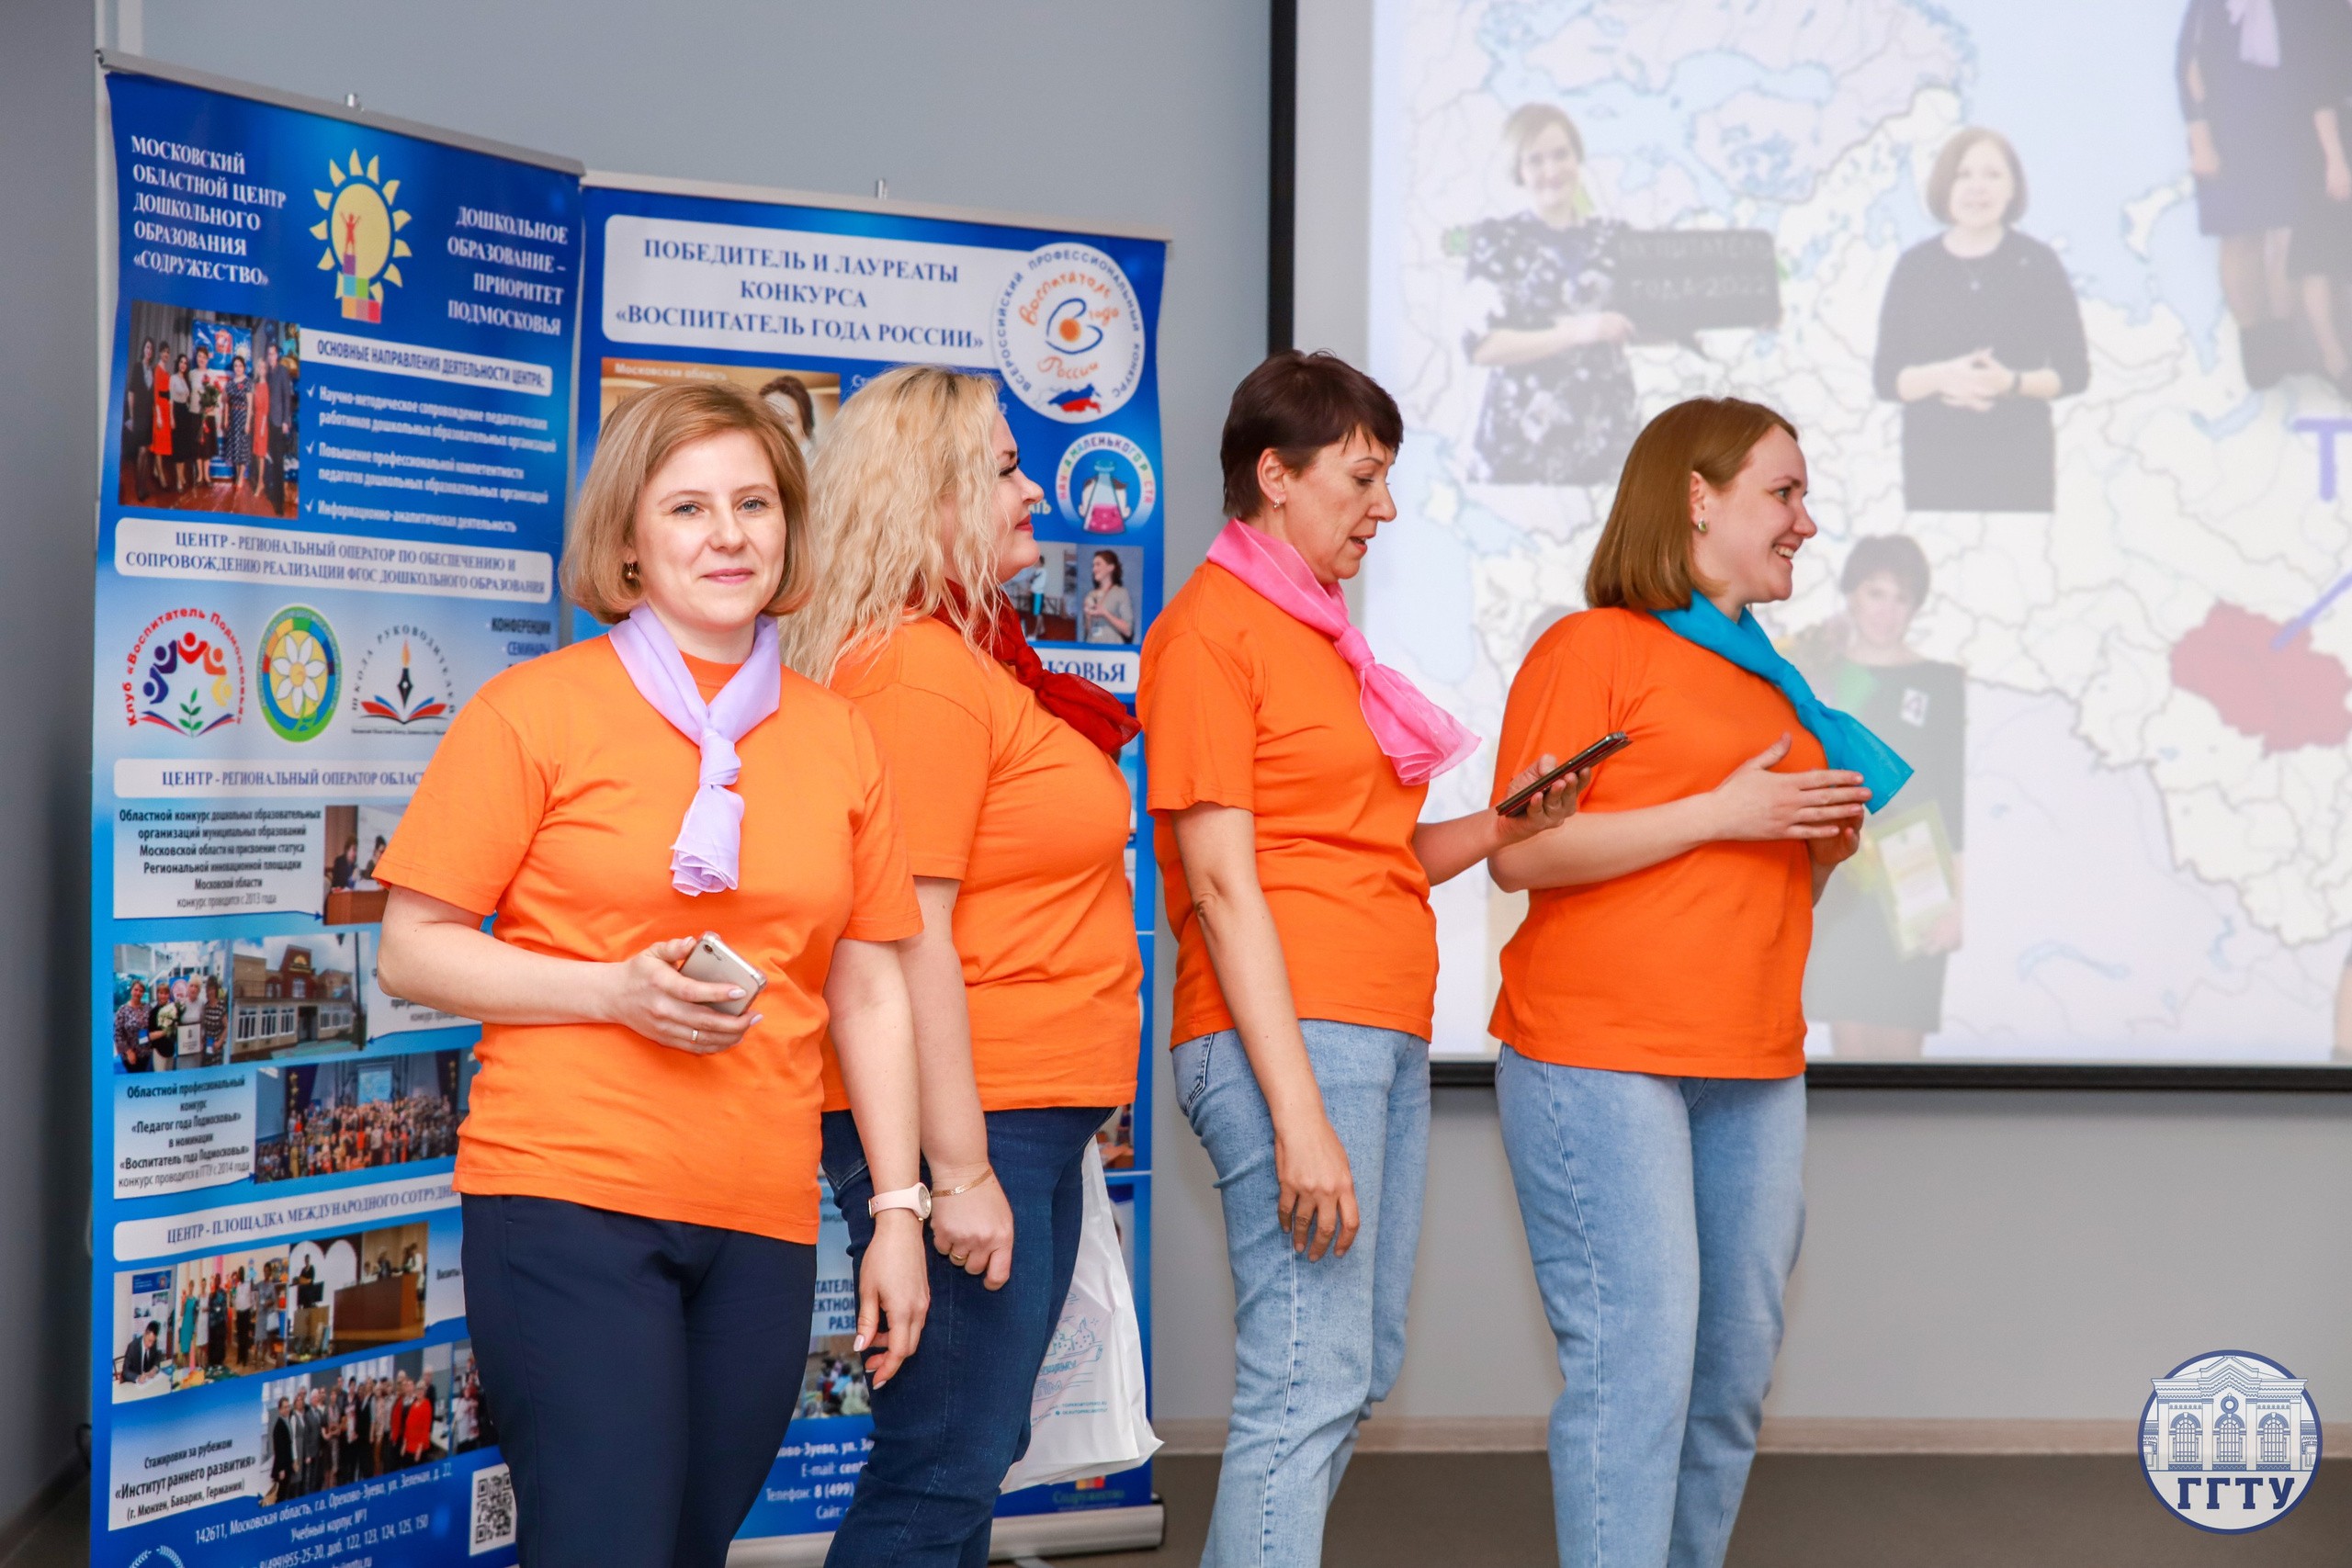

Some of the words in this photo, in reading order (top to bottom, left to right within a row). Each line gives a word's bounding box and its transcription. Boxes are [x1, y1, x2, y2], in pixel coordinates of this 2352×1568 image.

[130, 135, 246, 175] МОСКОВСКИЙ
[132, 164, 229, 200] ОБЛАСТНОЙ
[232, 183, 287, 209] ЦЕНТР
[132, 192, 261, 231] ДОШКОЛЬНОГО
[456, 205, 569, 245] ДОШКОЛЬНОЕ
[133, 220, 248, 256] ОБРАЗОВАНИЯ
[447, 236, 555, 274] ОБРАЗОВАНИЕ
[133, 249, 269, 286] «СОДРУЖЕСТВО»
[643, 238, 806, 271] ПОБЕДИТЕЛЬ
[813, 253, 829, 273] И
[834, 254, 958, 284] ЛАУРЕАТЫ
[473, 272, 565, 306] ПРИОРИТЕТ
[739, 279, 867, 309] КОНКУРСА
[447, 299, 562, 336] ПОДМОСКОВЬЯ
[616, 304, 805, 336] «ВОСПИТАТЕЛЬ
[811, 318, 871, 343] ГОДА
[878, 324, 984, 349] РОССИИ»
[997, 271, 1032, 392] ВСЕРОССИЙСКИЙ
[1027, 249, 1140, 333] ПРОФЕССИОНАЛЬНЫЙ
[1111, 343, 1140, 399] КОНКУРС
[317, 339, 369, 362] ОСНОВНЫЕ
[371, 347, 440, 372] НАПРАВЛЕНИЯ
[441, 358, 510, 383] ДЕЯТЕЛЬНОСТИ
[512, 367, 546, 389] ЦЕНТРА:
[615, 362, 683, 378] Московская
[175, 531, 229, 549] ЦЕНТР
[238, 536, 336, 557] РЕГИОНАЛЬНЫЙ
[338, 544, 396, 562] ОПЕРАТОР
[398, 549, 417, 564] ПО
[419, 550, 505, 570] ОБЕСПЕЧЕНИЮ
[508, 558, 516, 571] И
[125, 551, 261, 576] СОПРОВОЖДЕНИЮ
[263, 559, 345, 581] РЕАЛИЗАЦИИ
[347, 565, 379, 581] ФГОС
[379, 568, 468, 589] ДОШКОЛЬНОГО
[469, 576, 546, 594] ОБРАЗОВАНИЯ
[1046, 660, 1126, 682] КОВЬЯ
[121, 682, 138, 728] Клуб
[162, 771, 213, 787] ЦЕНТР
[221, 769, 320, 787] РЕГИОНАЛЬНЫЙ
[322, 771, 378, 786] ОПЕРАТОР
[119, 808, 173, 822] Областной
[175, 809, 210, 825] конкурс
[138, 825, 200, 842] организаций
[140, 842, 197, 857] Московской
[143, 860, 209, 875] Региональной
[176, 897, 207, 911] конкурс
[127, 1083, 178, 1100] Областной
[180, 1099, 208, 1113] конкурс
[131, 1118, 174, 1134] «Педагог
[119, 1154, 182, 1171] «Воспитатель
[118, 1174, 154, 1190] конкурс
[166, 1226, 204, 1245] ЦЕНТР
[211, 1212, 285, 1235] ПЛОЩАДКА
[288, 1194, 400, 1224] МЕЖДУНАРОДНОГО
[144, 1451, 187, 1470] Стажировки
[188, 1447, 198, 1458] за
[198, 1438, 233, 1458] рубежом
[115, 1476, 167, 1500] «Институт
[167, 1469, 206, 1488] раннего
[207, 1455, 256, 1479] развития»
[814, 1483, 822, 1498] 8
[824, 1482, 854, 1498] (499)
[138, 1499, 170, 1517] Мюнхен,
[171, 1490, 205, 1508] Бавария,
[206, 1478, 245, 1498] Германия)
[196, 1523, 228, 1544] 142611,
[230, 1511, 277, 1536] Московская
[279, 1503, 312, 1521] область,
